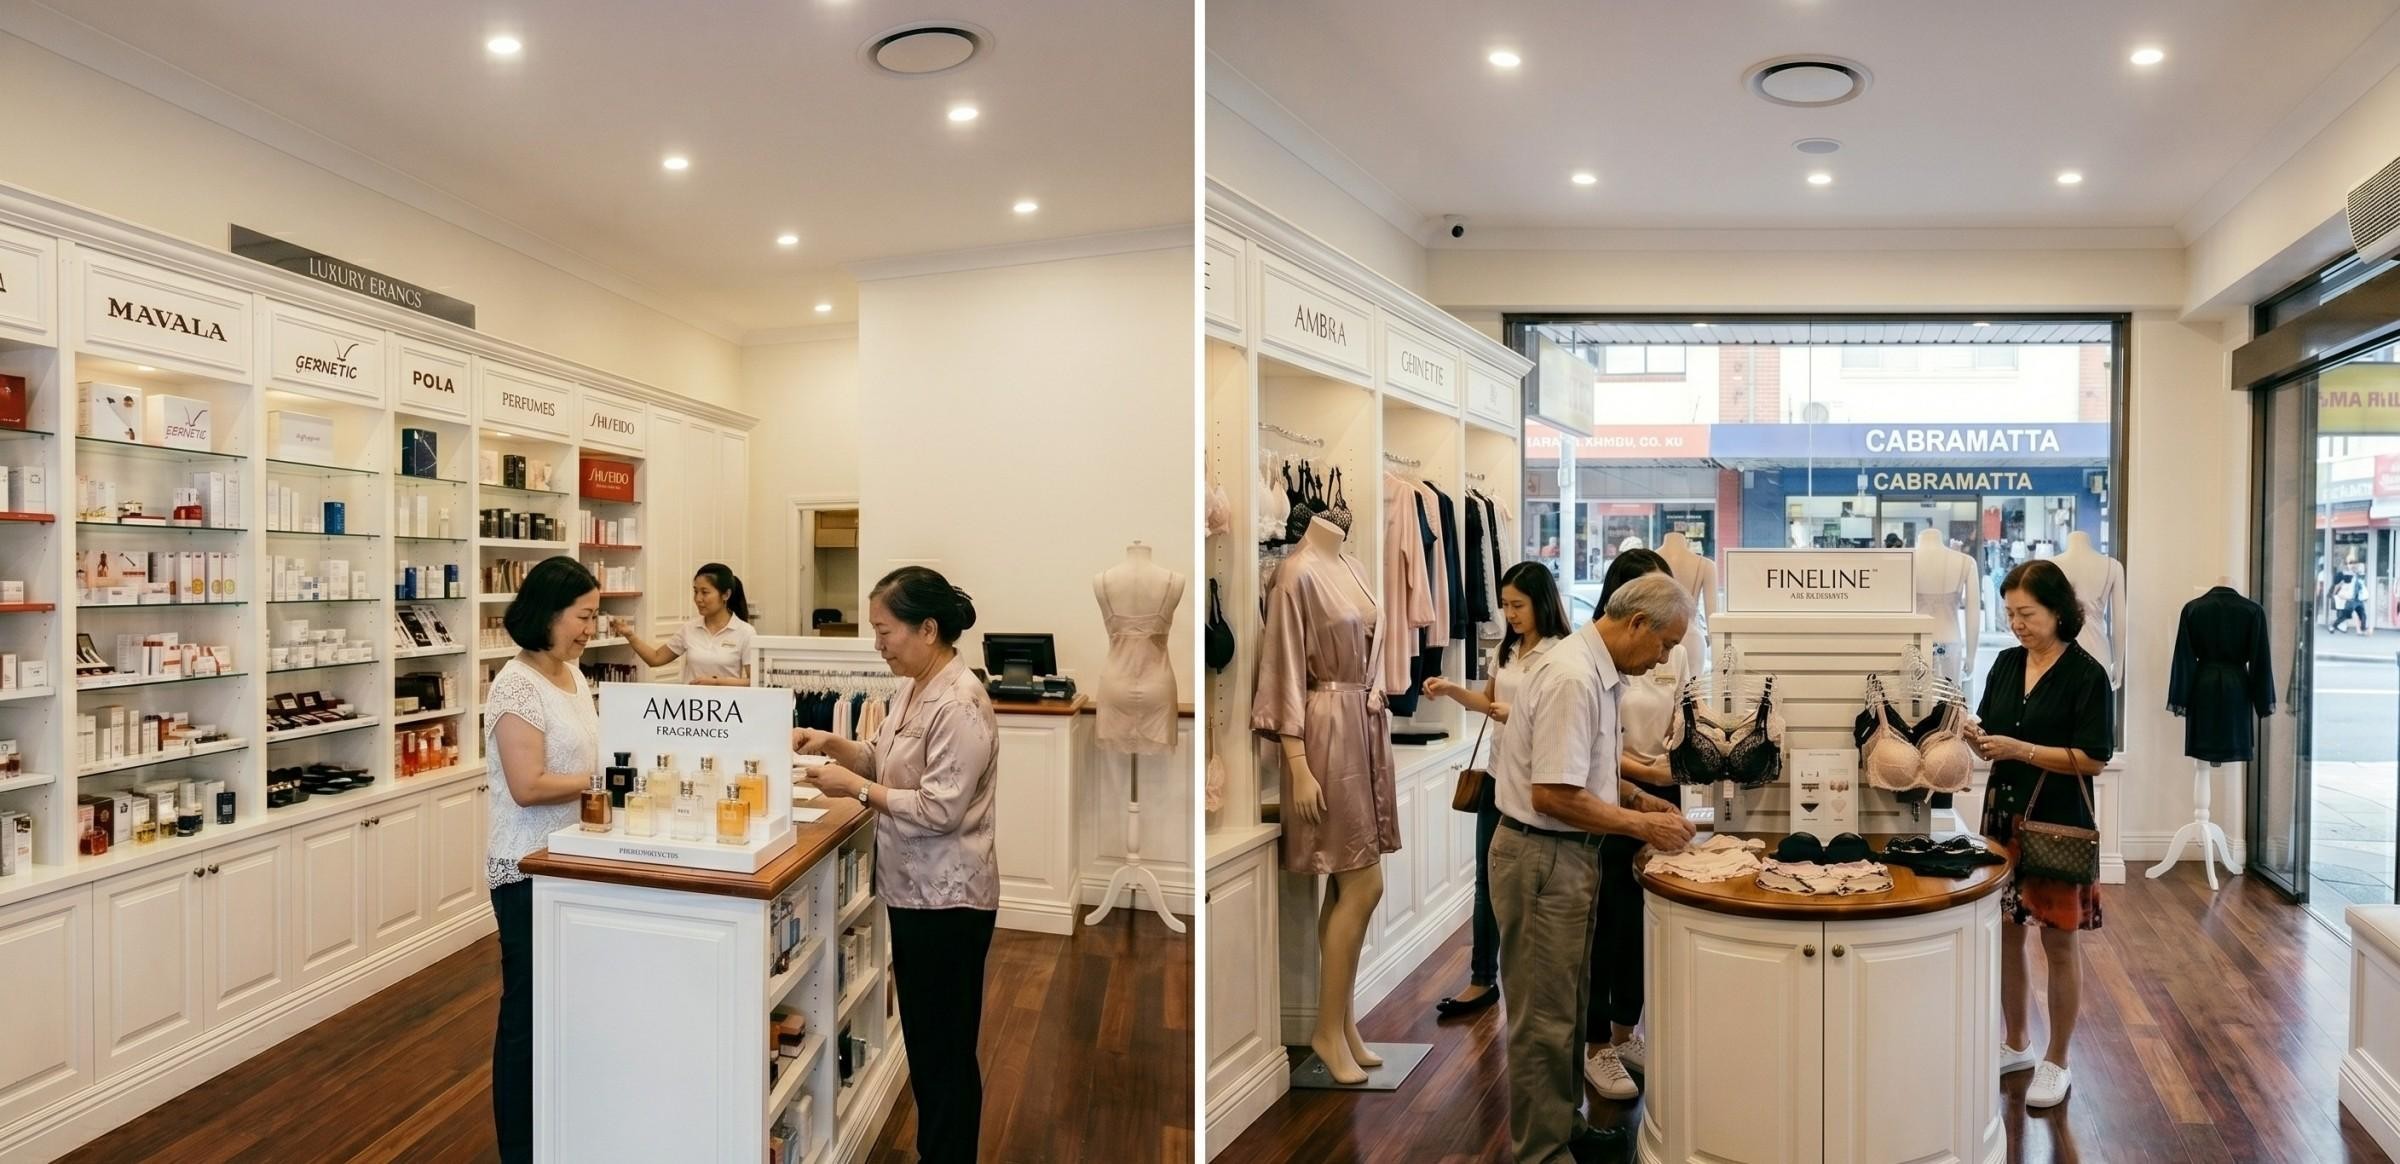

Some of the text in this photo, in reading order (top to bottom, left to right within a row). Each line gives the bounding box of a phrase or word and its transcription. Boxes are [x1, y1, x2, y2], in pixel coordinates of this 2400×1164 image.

[309, 257, 367, 290] LUXURY
[107, 297, 228, 342] MAVALA
[1294, 303, 1347, 347] AMBRA
[295, 354, 358, 380] GERNETIC
[413, 370, 455, 394] POLA
[589, 412, 635, 435] SHISEIDO
[1638, 436, 1662, 448] CO.
[1665, 436, 1684, 448] XU
[1865, 427, 2060, 454] CABRAMATTA
[588, 466, 629, 485] SHISEIDO
[1873, 472, 2033, 491] CABRAMATTA
[643, 697, 743, 724] AMBRA
[656, 725, 729, 739] FRAGRANCES
